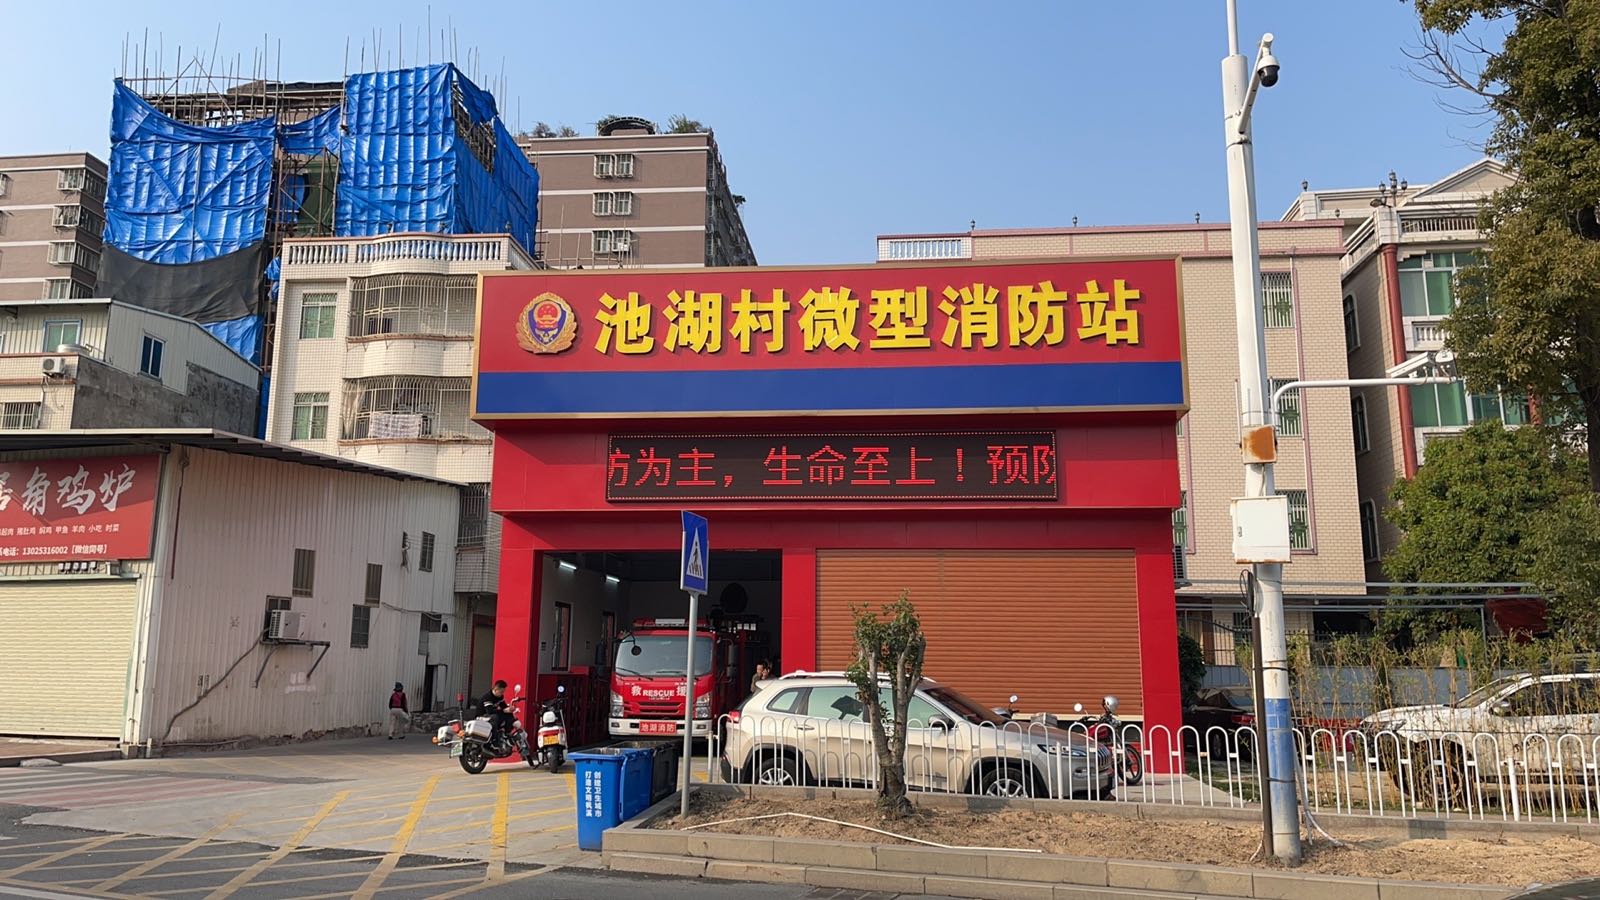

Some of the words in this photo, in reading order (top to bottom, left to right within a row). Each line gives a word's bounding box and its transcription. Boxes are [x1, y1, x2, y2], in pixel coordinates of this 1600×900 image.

[595, 279, 1140, 354] 池湖村微型消防站
[72, 525, 85, 533] 羊肉
[22, 546, 68, 555] 13025316002
[631, 686, 641, 696] 救
[643, 689, 675, 697] RESCUE
